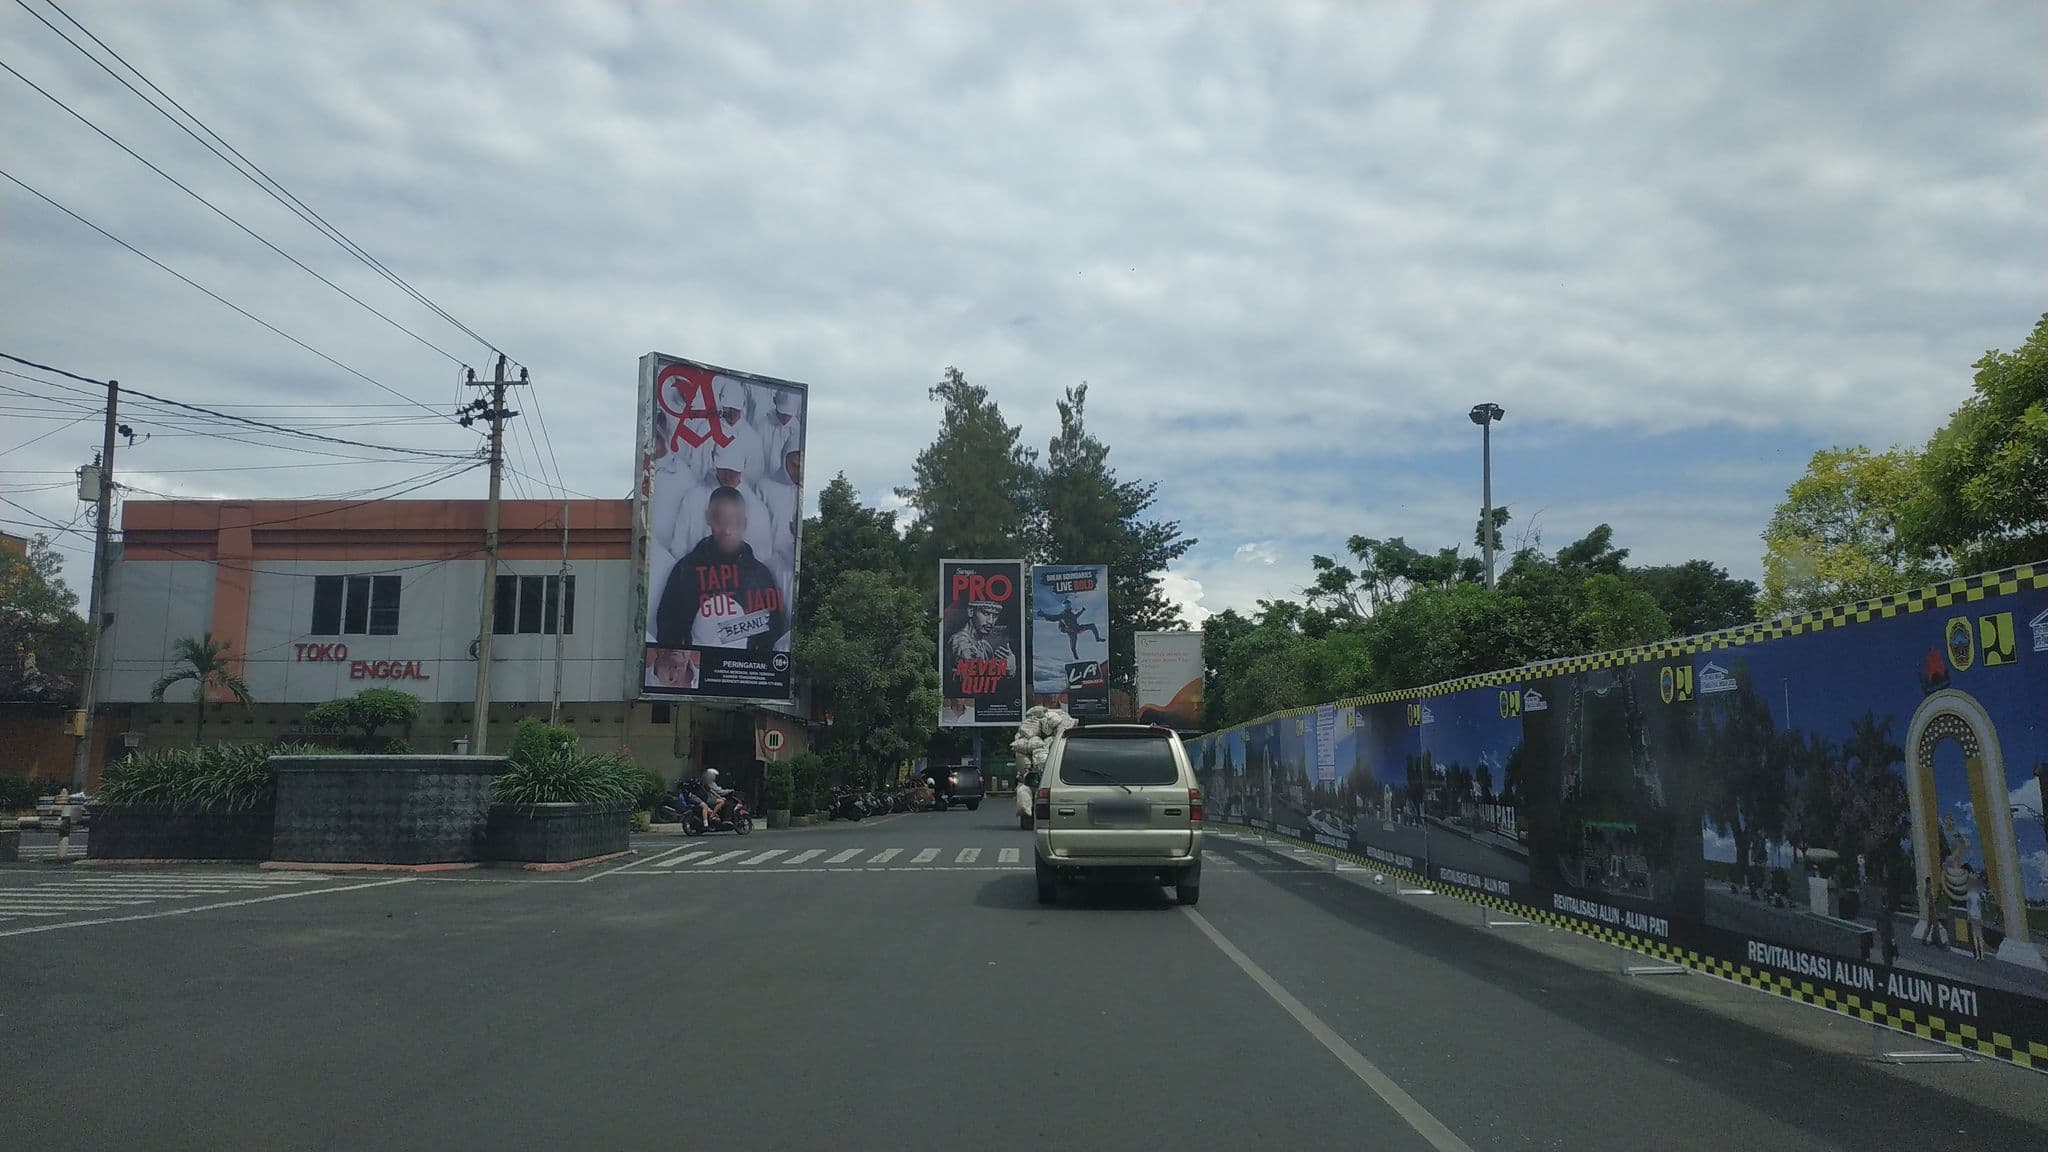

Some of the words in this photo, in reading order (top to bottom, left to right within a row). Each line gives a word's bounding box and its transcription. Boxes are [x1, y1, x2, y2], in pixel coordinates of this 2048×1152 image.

[696, 564, 740, 591] TAPI
[952, 574, 1013, 602] PRO
[1056, 581, 1073, 592] LIVE
[699, 592, 738, 618] GUE
[724, 616, 764, 638] BERANI
[294, 643, 348, 662] TOKO
[350, 660, 430, 680] ENGGAL
[722, 660, 768, 670] PERINGATAN:
[956, 658, 1008, 676] NEVER
[1553, 893, 1598, 919] REVITALISASI
[1599, 904, 1619, 924] ALUN
[1625, 911, 1648, 933] ALUN
[1648, 916, 1669, 938] PATI
[1748, 940, 1831, 981] REVITALISASI
[1835, 965, 1875, 992] ALUN
[1887, 974, 1933, 1006] ALUN
[1937, 984, 1978, 1017] PATI
